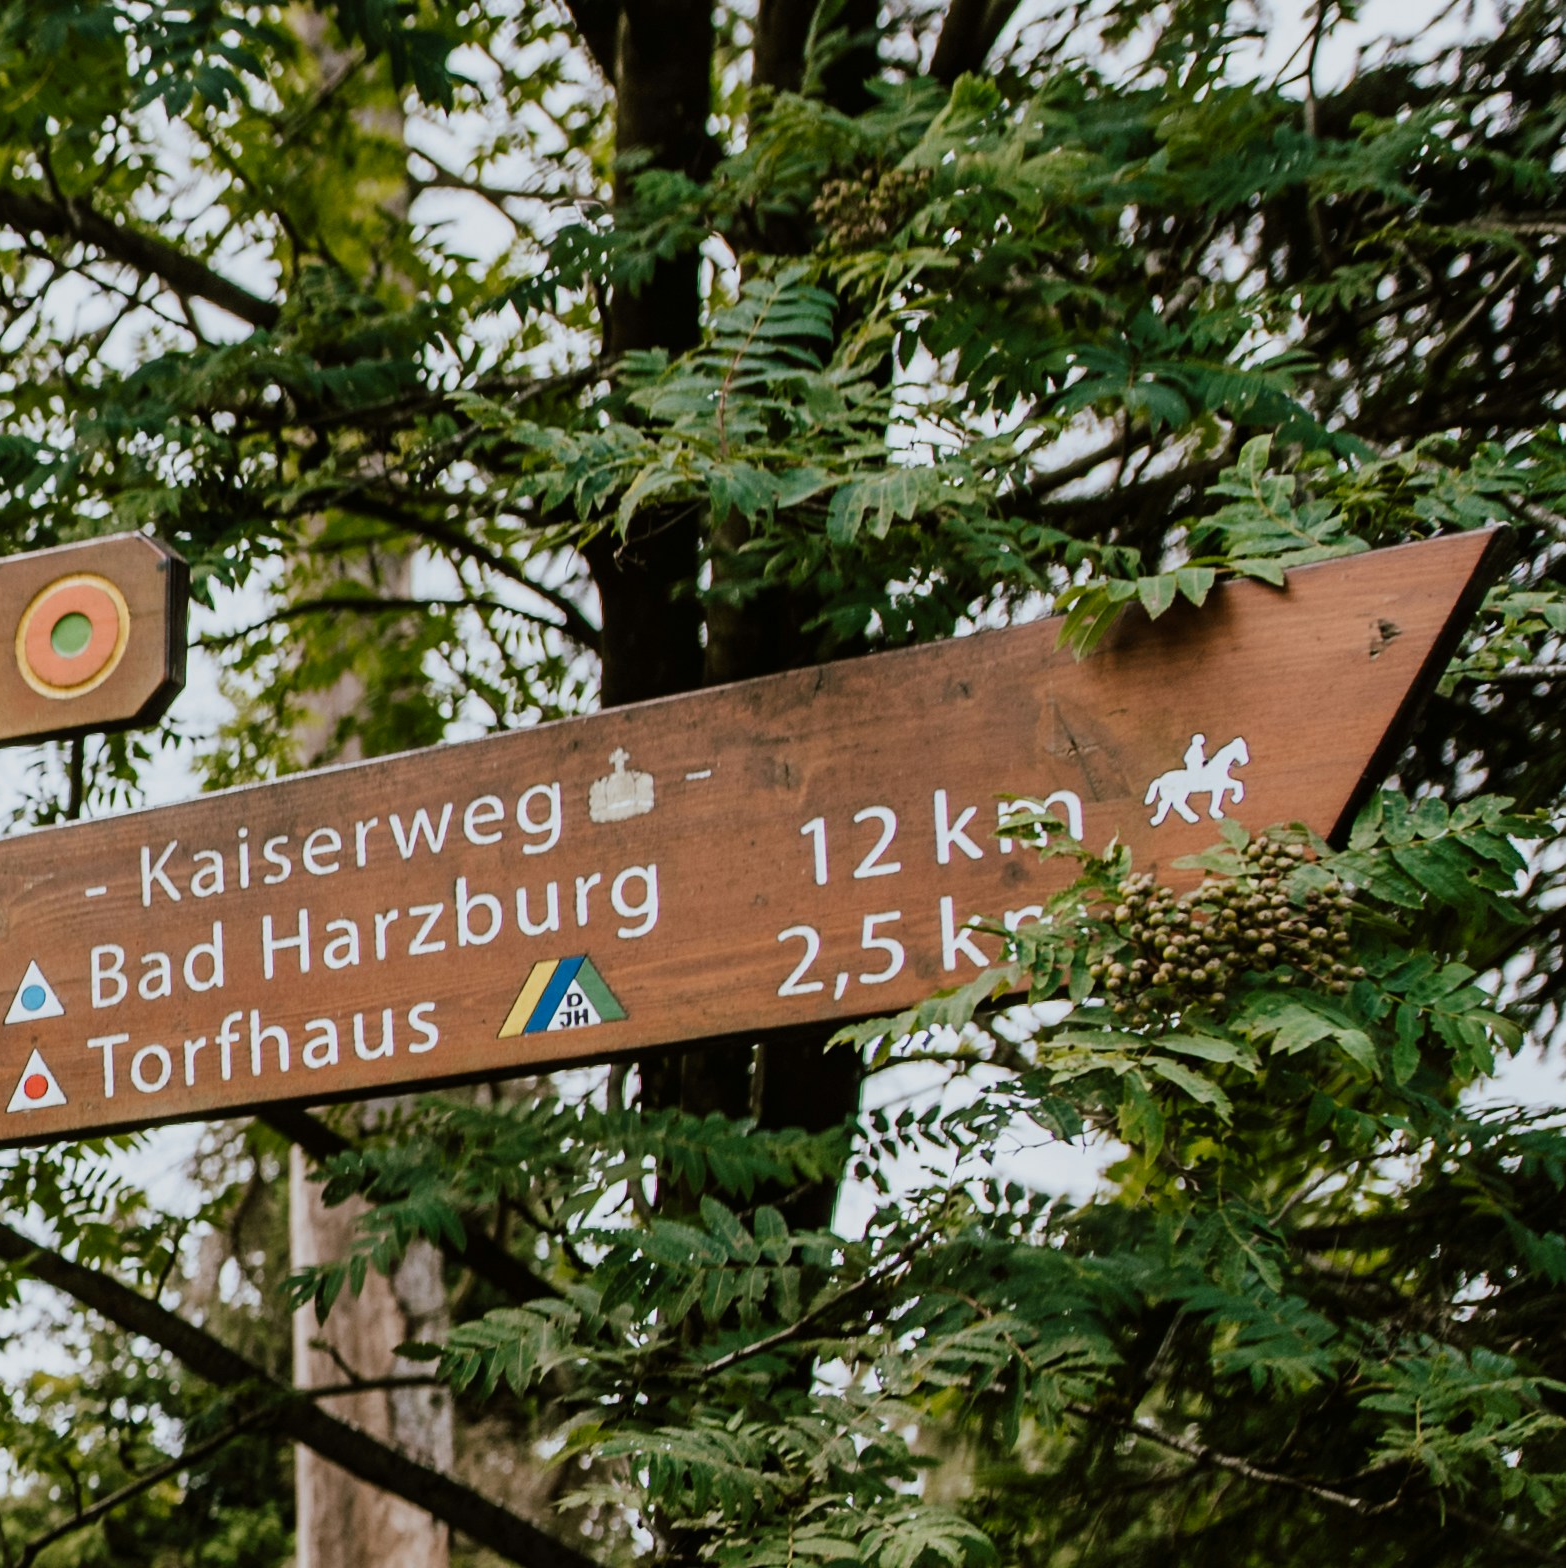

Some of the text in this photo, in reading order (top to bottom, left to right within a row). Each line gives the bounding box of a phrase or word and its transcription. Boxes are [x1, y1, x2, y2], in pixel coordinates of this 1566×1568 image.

[90, 919, 226, 1010] Bad
[261, 863, 660, 981] Harzburg
[799, 804, 902, 886] 12
[933, 788, 1084, 866] km
[139, 780, 564, 909] Kaiserweg
[86, 1001, 440, 1099] Torfhaus
[776, 910, 905, 1001] 2,5
[938, 895, 1089, 972] k
